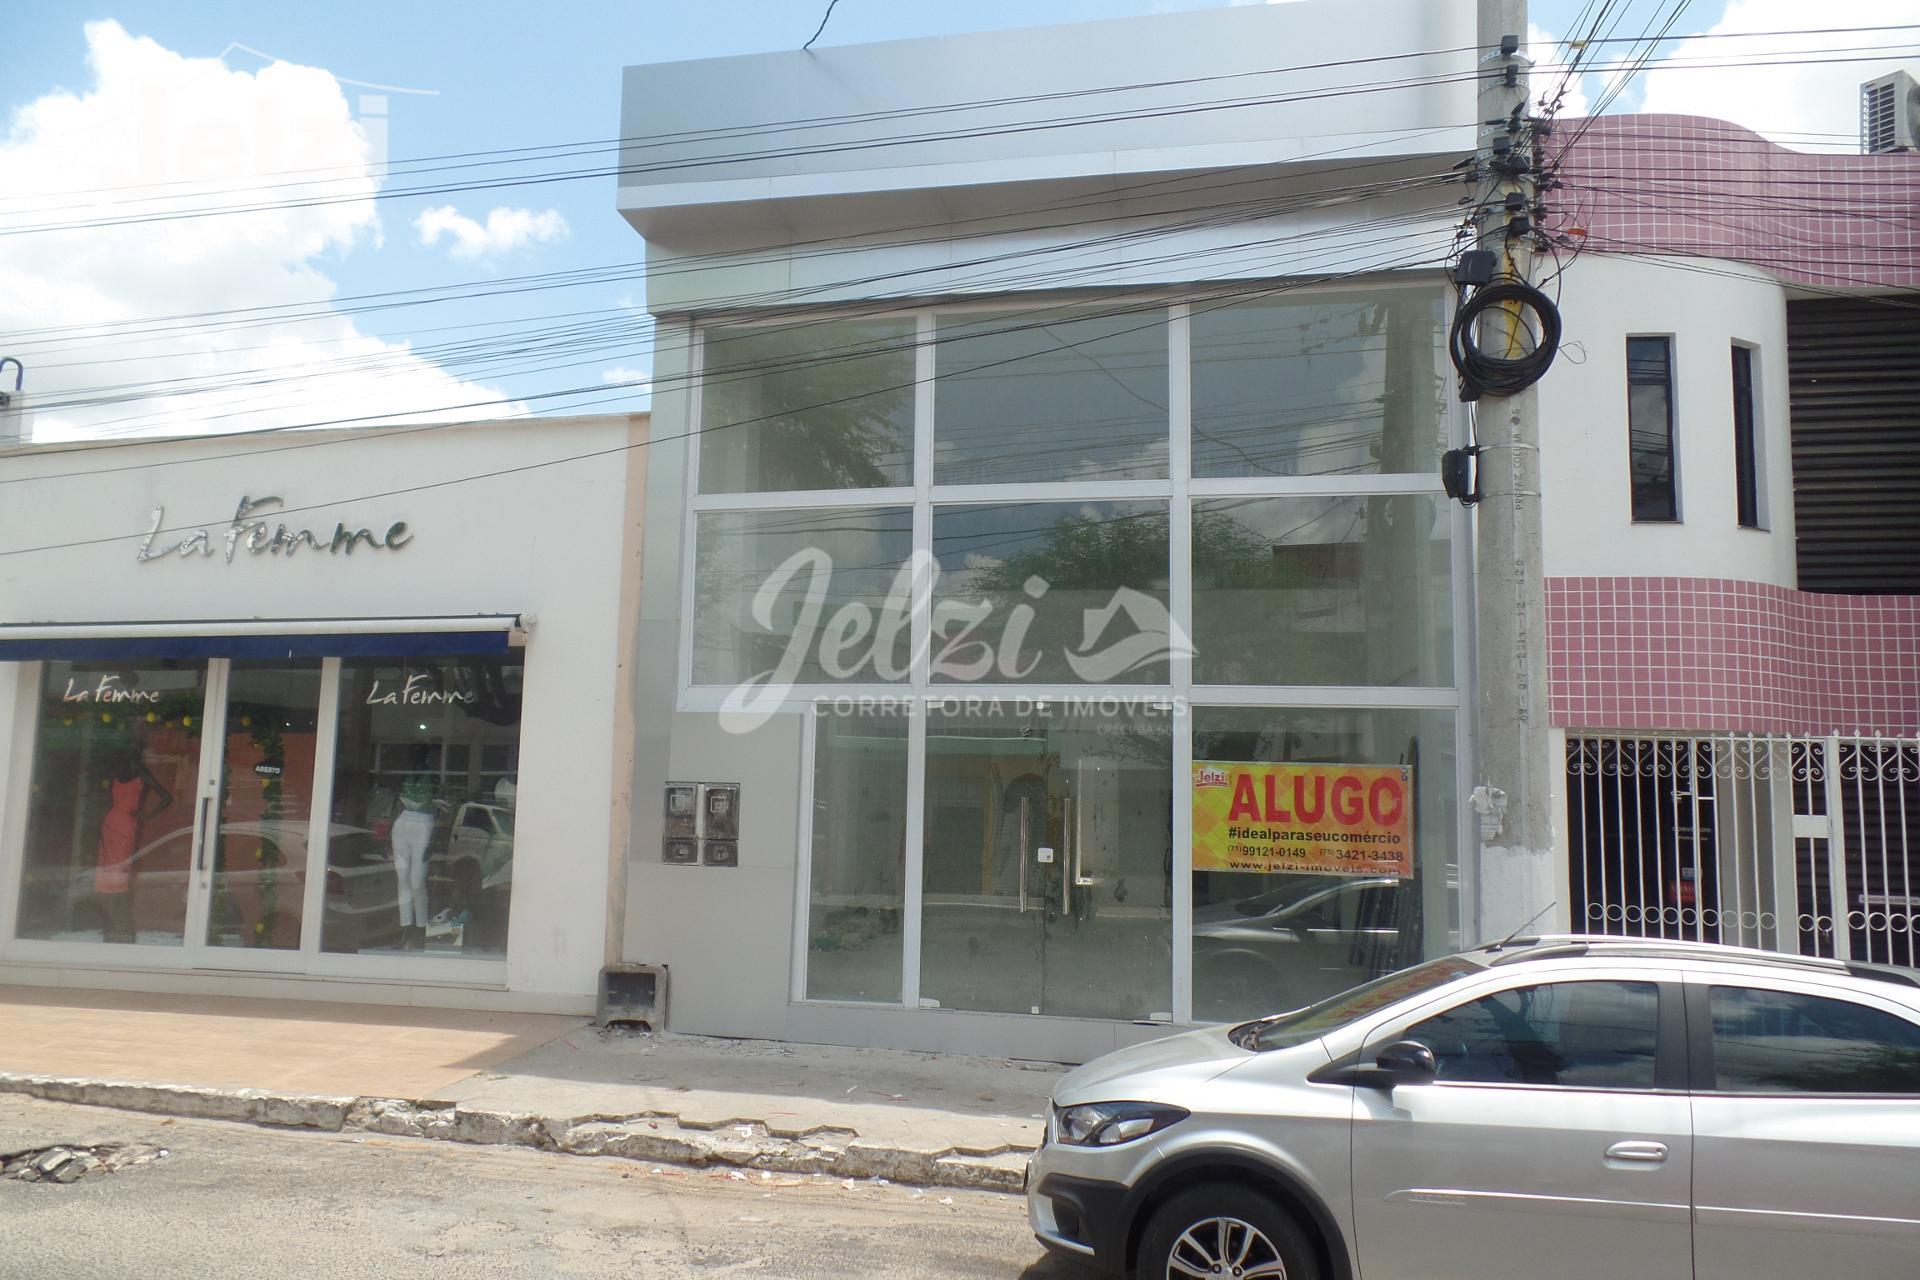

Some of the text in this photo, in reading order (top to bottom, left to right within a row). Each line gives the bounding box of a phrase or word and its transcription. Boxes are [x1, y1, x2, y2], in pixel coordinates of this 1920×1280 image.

[137, 495, 414, 566] La Femme
[63, 674, 160, 703] La Femme
[366, 674, 475, 705] La Femme
[253, 765, 281, 774] ABERTO
[1228, 774, 1403, 826] ALUGO
[1228, 826, 1401, 844] #idealparaseucomércio
